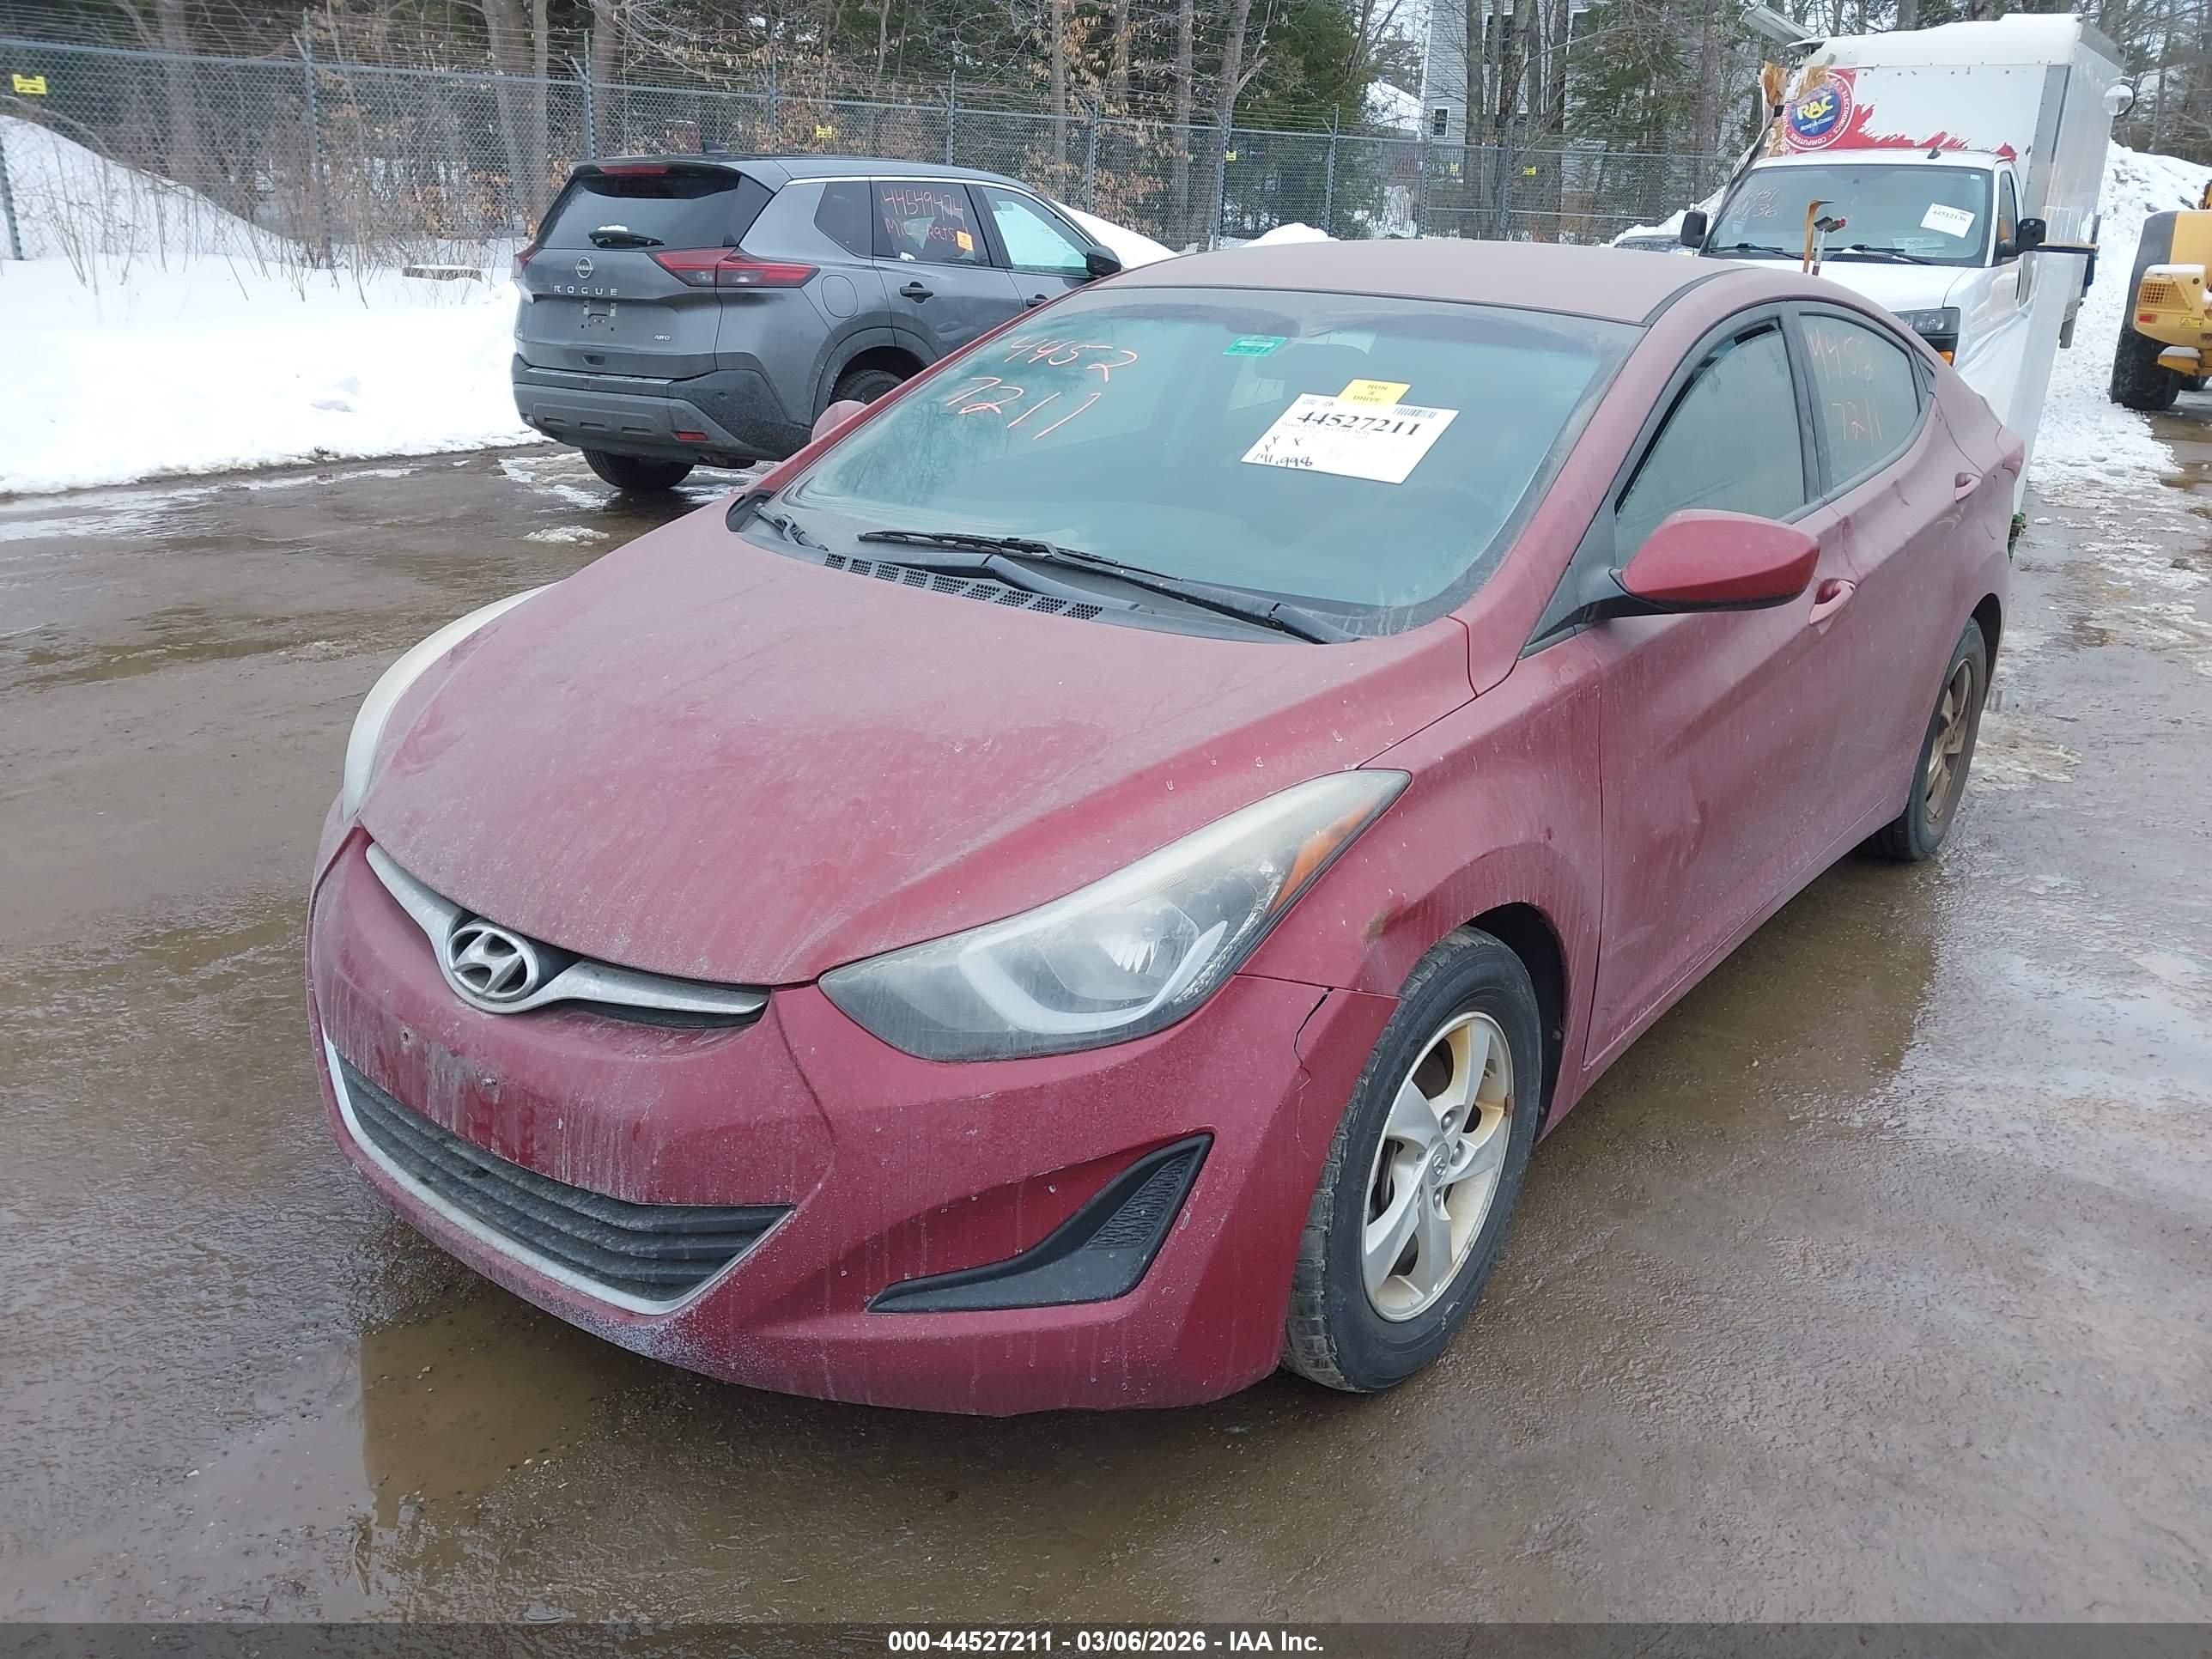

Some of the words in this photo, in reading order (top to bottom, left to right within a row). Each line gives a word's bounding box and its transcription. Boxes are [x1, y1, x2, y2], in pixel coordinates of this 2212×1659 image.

[1796, 95, 1834, 120] RAC
[1833, 90, 1850, 134] ELECTRONICS
[1790, 131, 1827, 146] COMPUTERS
[554, 285, 618, 296] ROGUE
[653, 333, 671, 342] AWD
[1004, 336, 1138, 383] 4452
[946, 377, 1101, 440] 7211
[1297, 411, 1422, 435] 44527211
